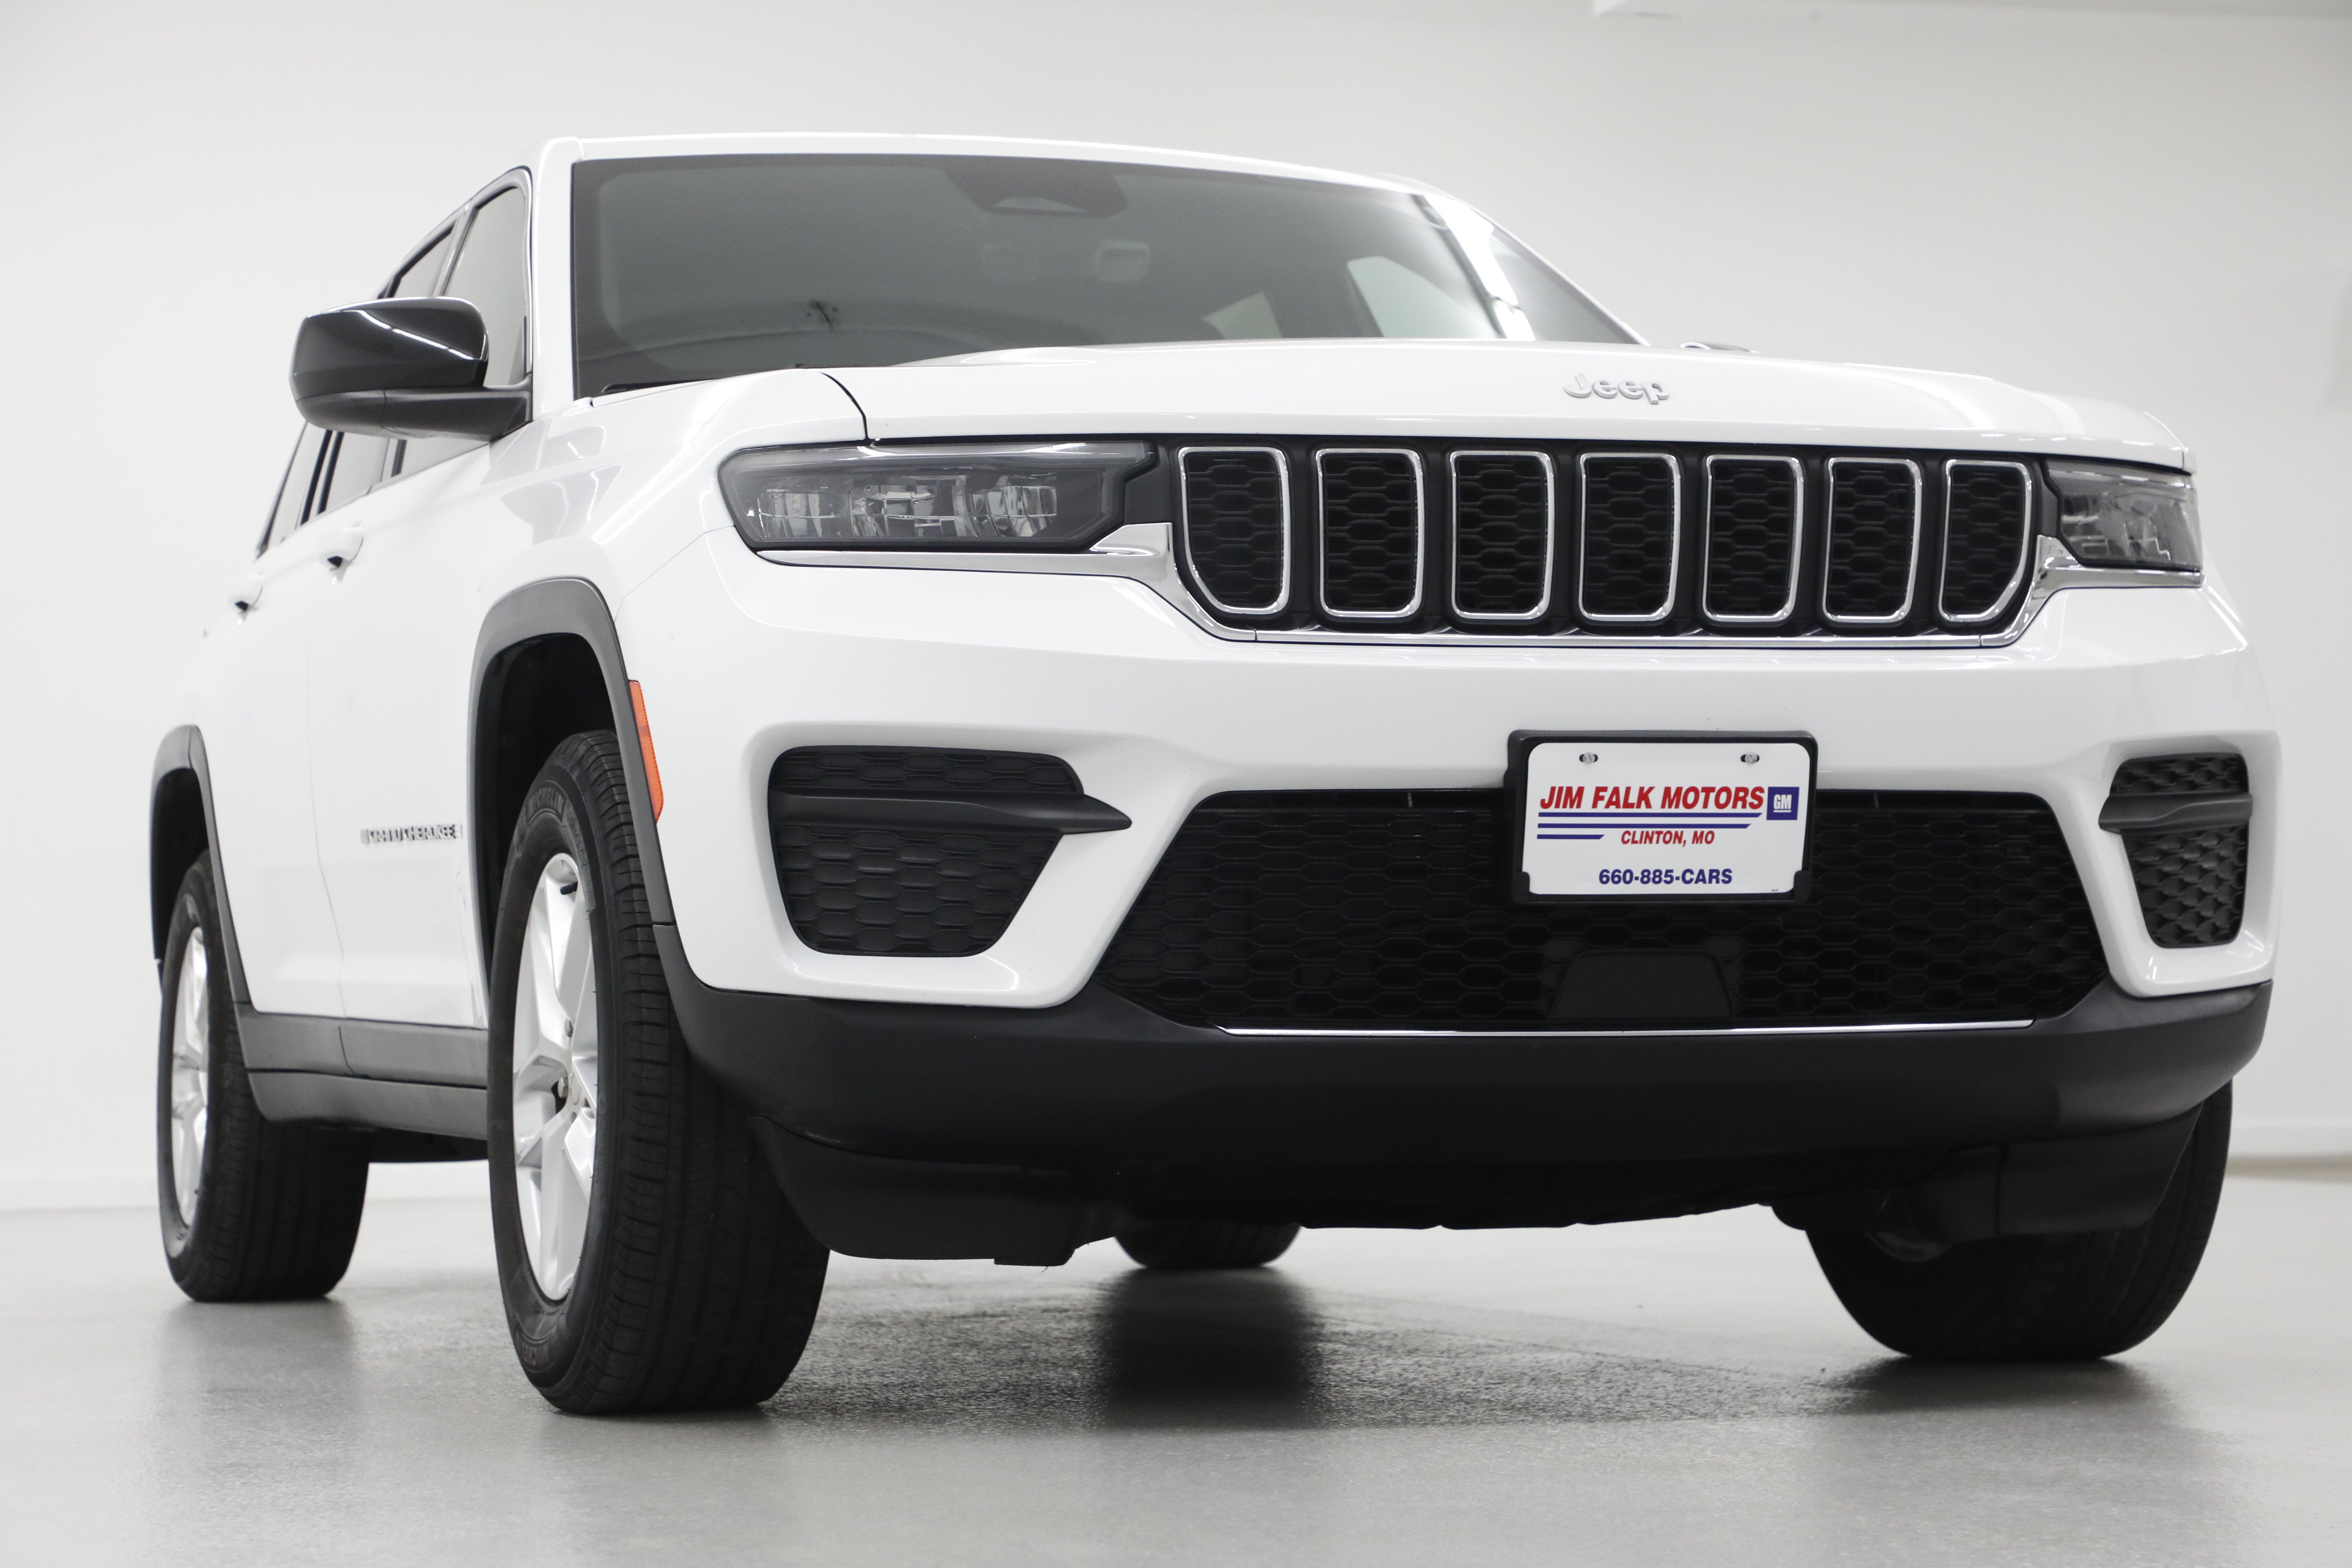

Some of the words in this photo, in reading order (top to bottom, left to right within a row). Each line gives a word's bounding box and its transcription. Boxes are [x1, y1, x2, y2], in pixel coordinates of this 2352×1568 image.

[1563, 373, 1669, 404] Jeep
[1540, 786, 1585, 809] JIM
[1592, 786, 1655, 809] FALK
[1661, 786, 1765, 809] MOTORS
[1773, 794, 1792, 809] GM
[1621, 830, 1687, 846] CLINTON,
[1692, 830, 1715, 844] MO
[1599, 869, 1732, 884] 660-885-CARS
